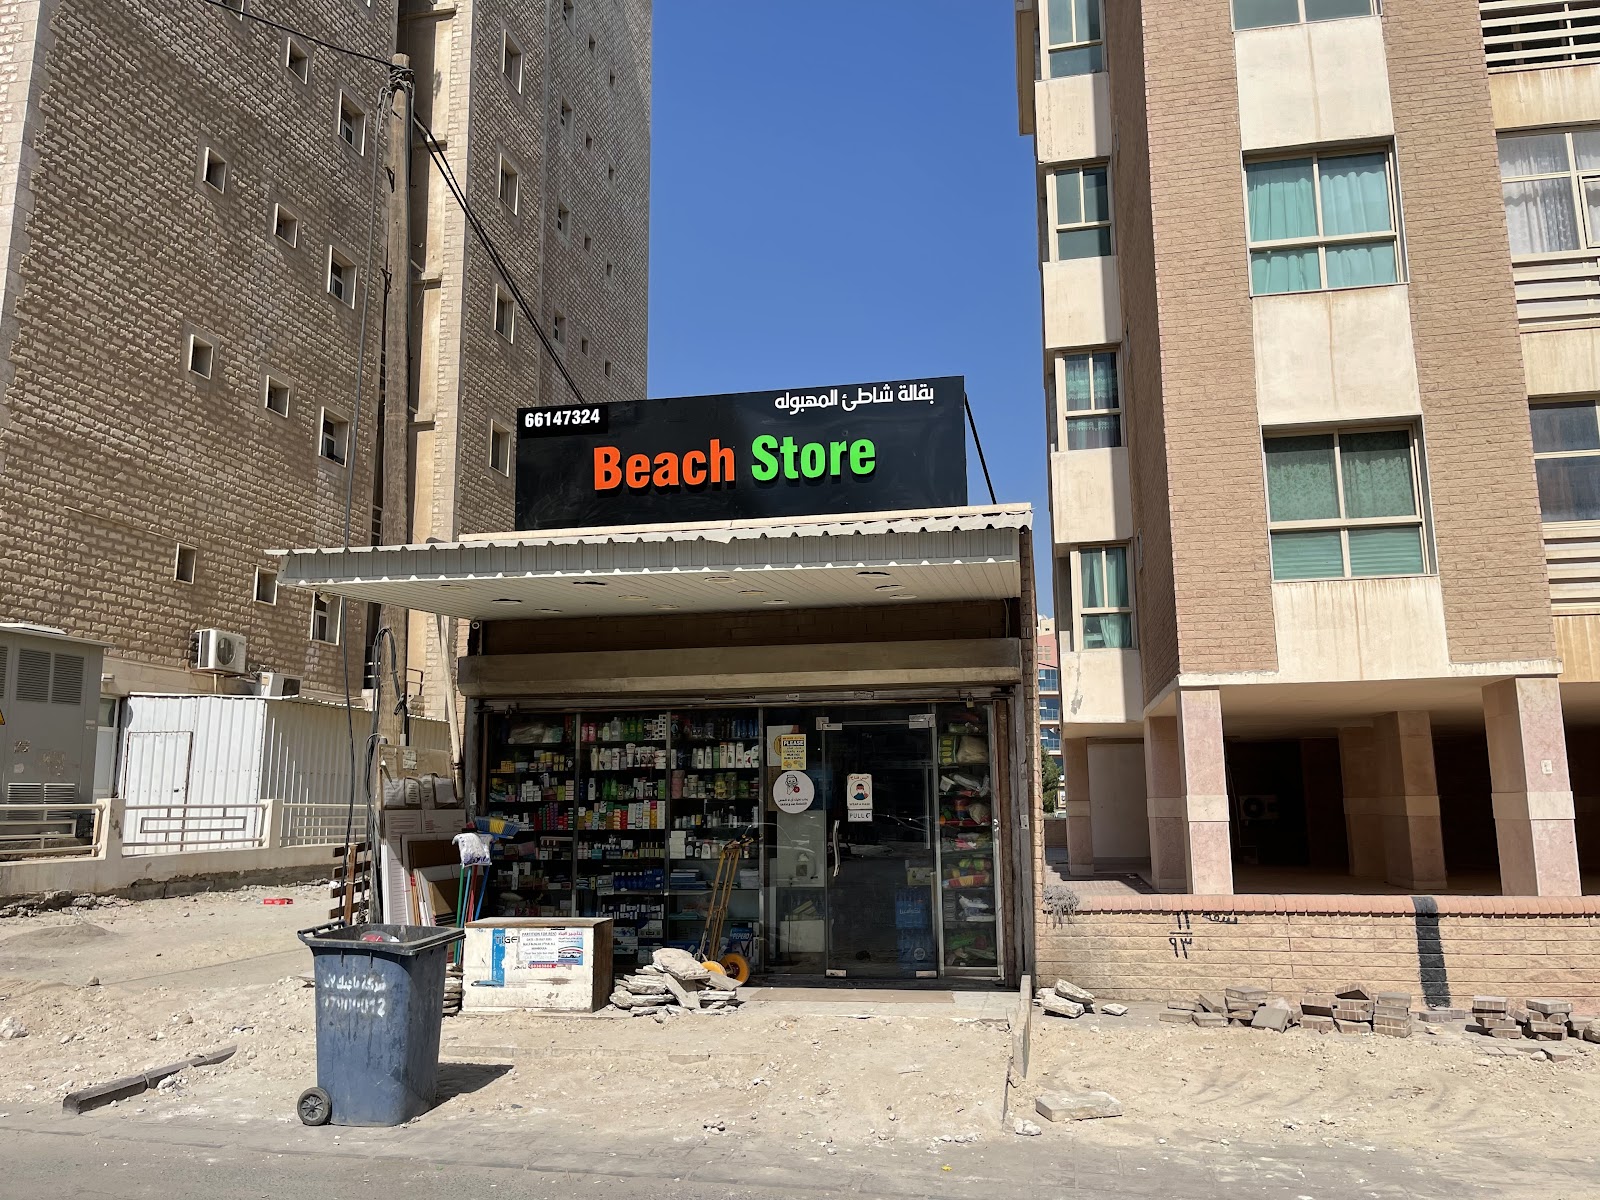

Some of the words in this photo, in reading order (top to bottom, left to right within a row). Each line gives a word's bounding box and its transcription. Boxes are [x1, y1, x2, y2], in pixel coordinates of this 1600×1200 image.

[775, 389, 838, 415] المهبوله
[842, 384, 894, 411] شاطئ
[898, 383, 934, 405] بقالة
[524, 409, 600, 428] 66147324
[594, 438, 735, 491] Beach
[751, 434, 876, 482] Store
